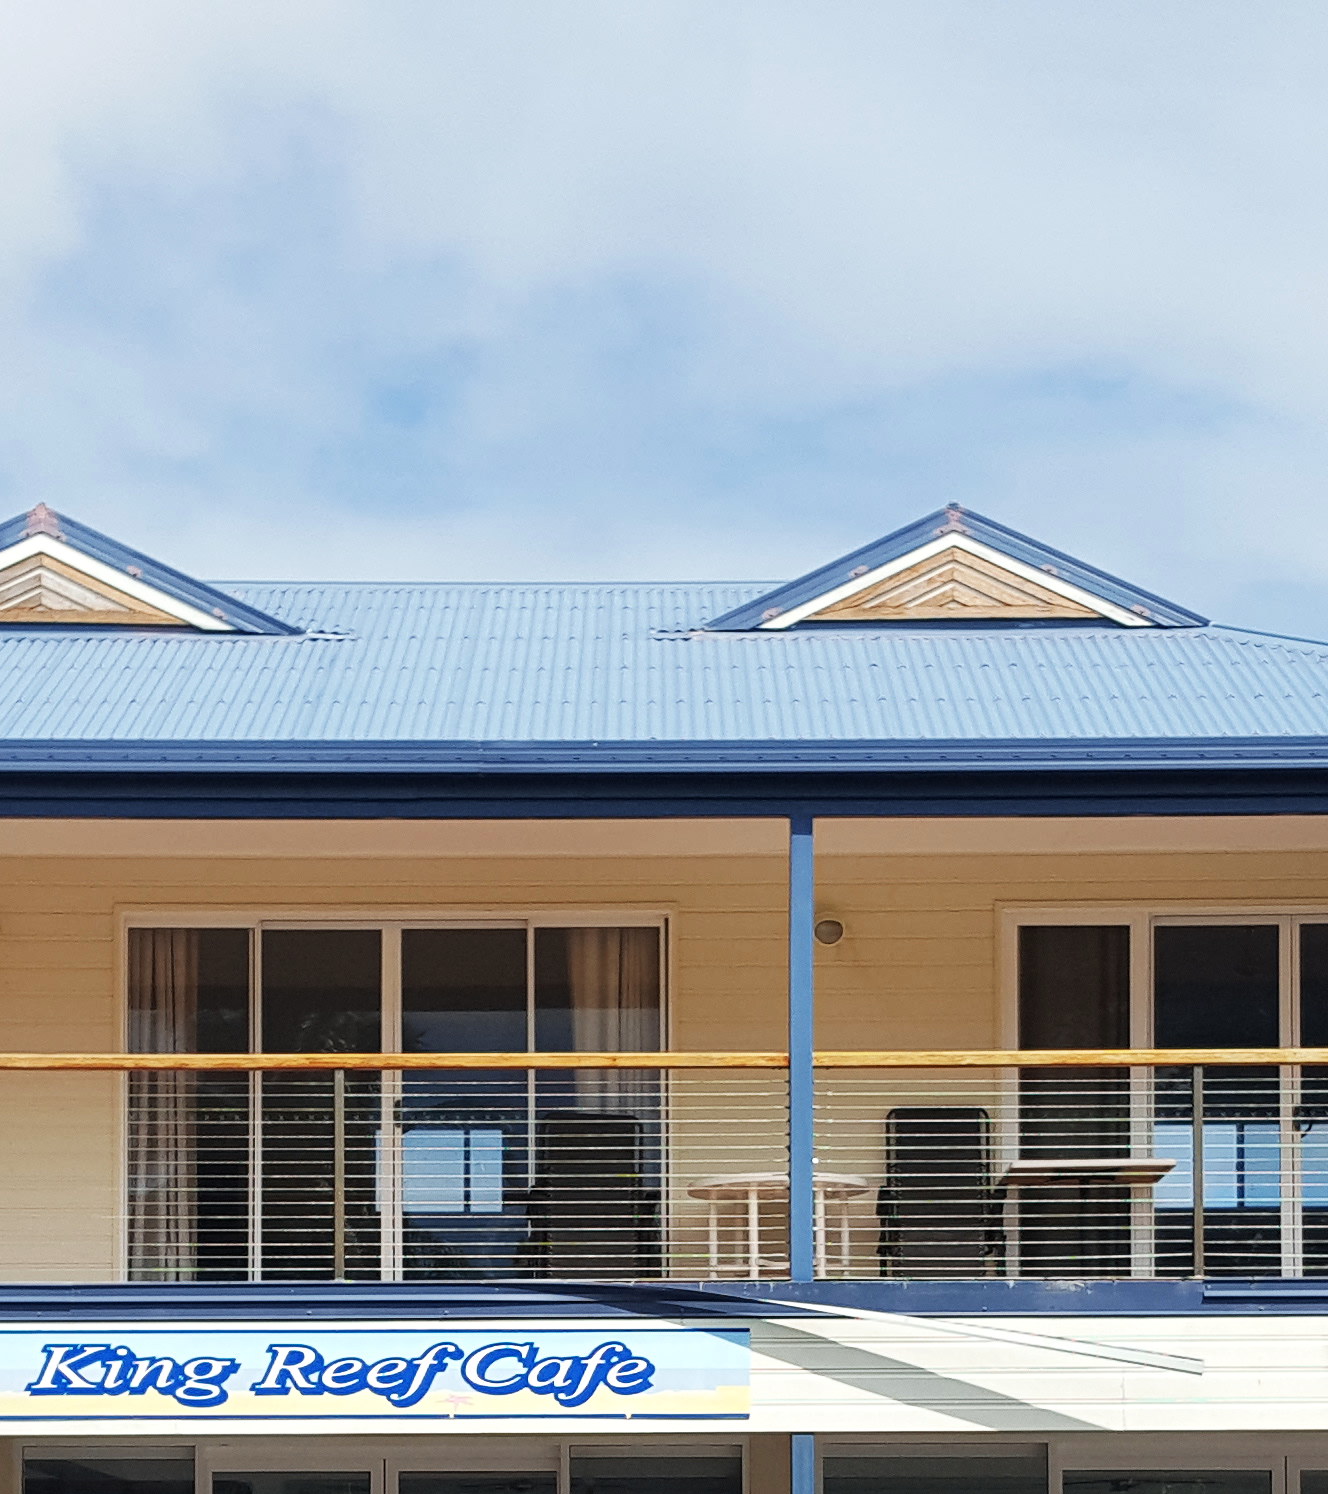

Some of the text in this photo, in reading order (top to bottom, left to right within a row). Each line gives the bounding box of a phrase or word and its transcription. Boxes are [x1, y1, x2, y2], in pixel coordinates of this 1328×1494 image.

[25, 1342, 655, 1407] King Reef Cafe
